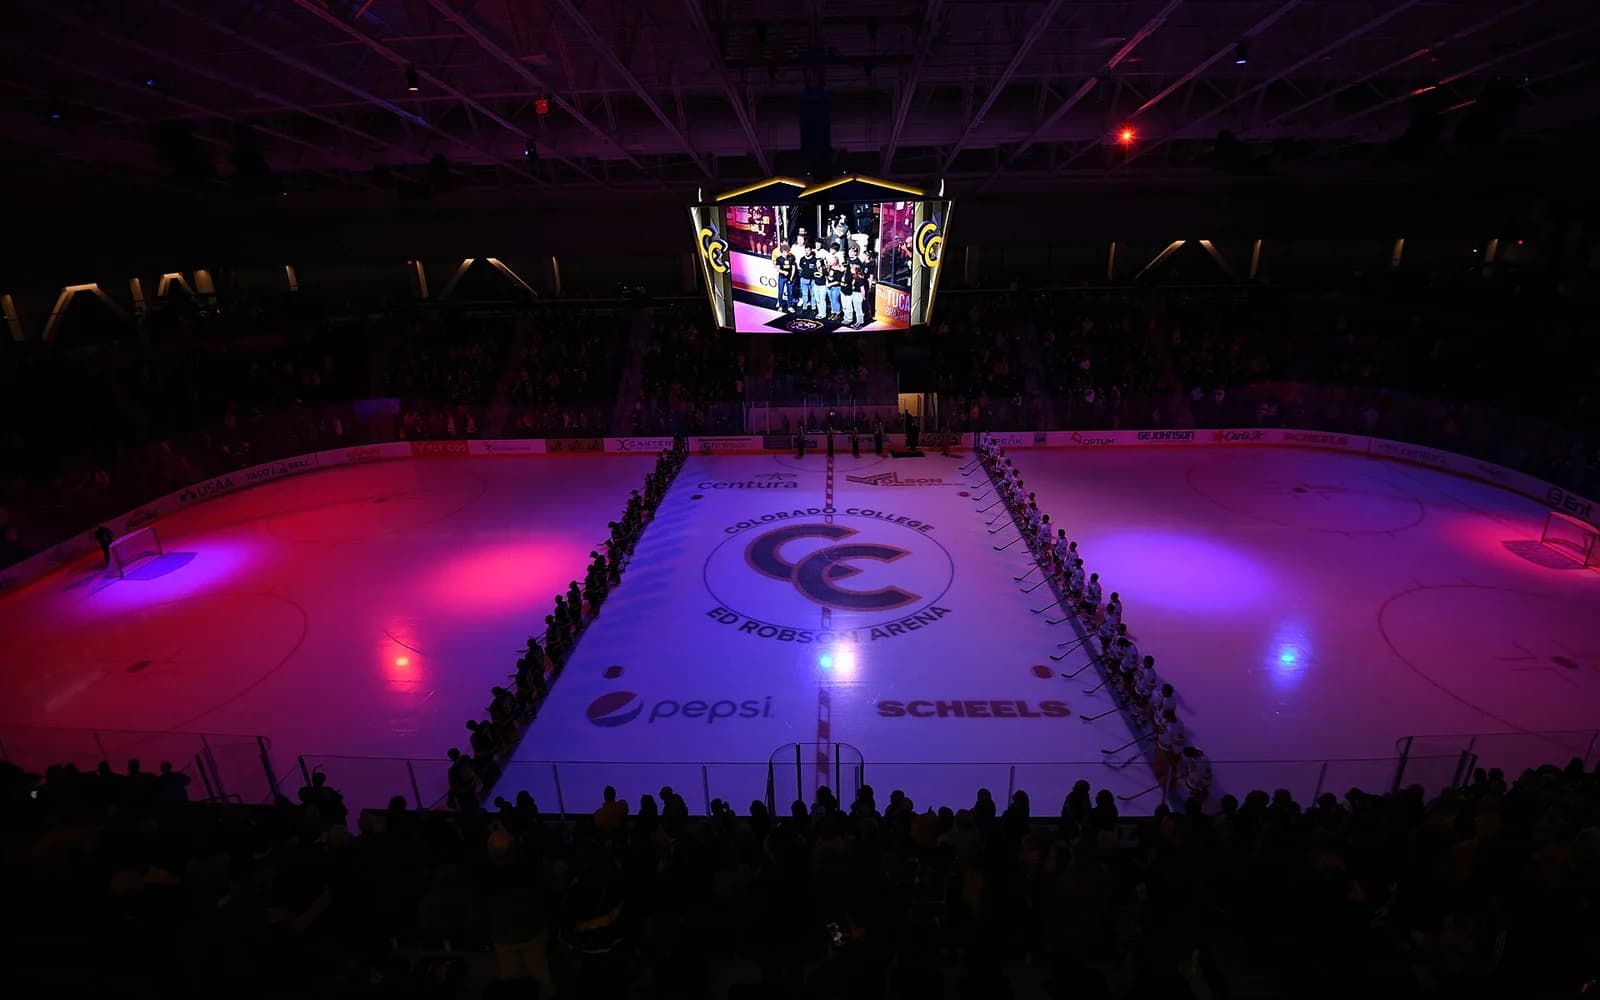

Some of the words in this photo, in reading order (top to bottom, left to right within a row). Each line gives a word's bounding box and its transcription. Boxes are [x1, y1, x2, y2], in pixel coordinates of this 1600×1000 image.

[196, 477, 233, 497] USAA
[697, 478, 799, 489] centura
[1564, 495, 1593, 518] Ent
[724, 507, 837, 535] COLORADO
[845, 507, 936, 533] COLLEGE
[706, 606, 739, 626] ED
[870, 606, 953, 641] ARENA
[648, 695, 774, 723] pepsi
[876, 700, 1071, 718] SCHEELS
